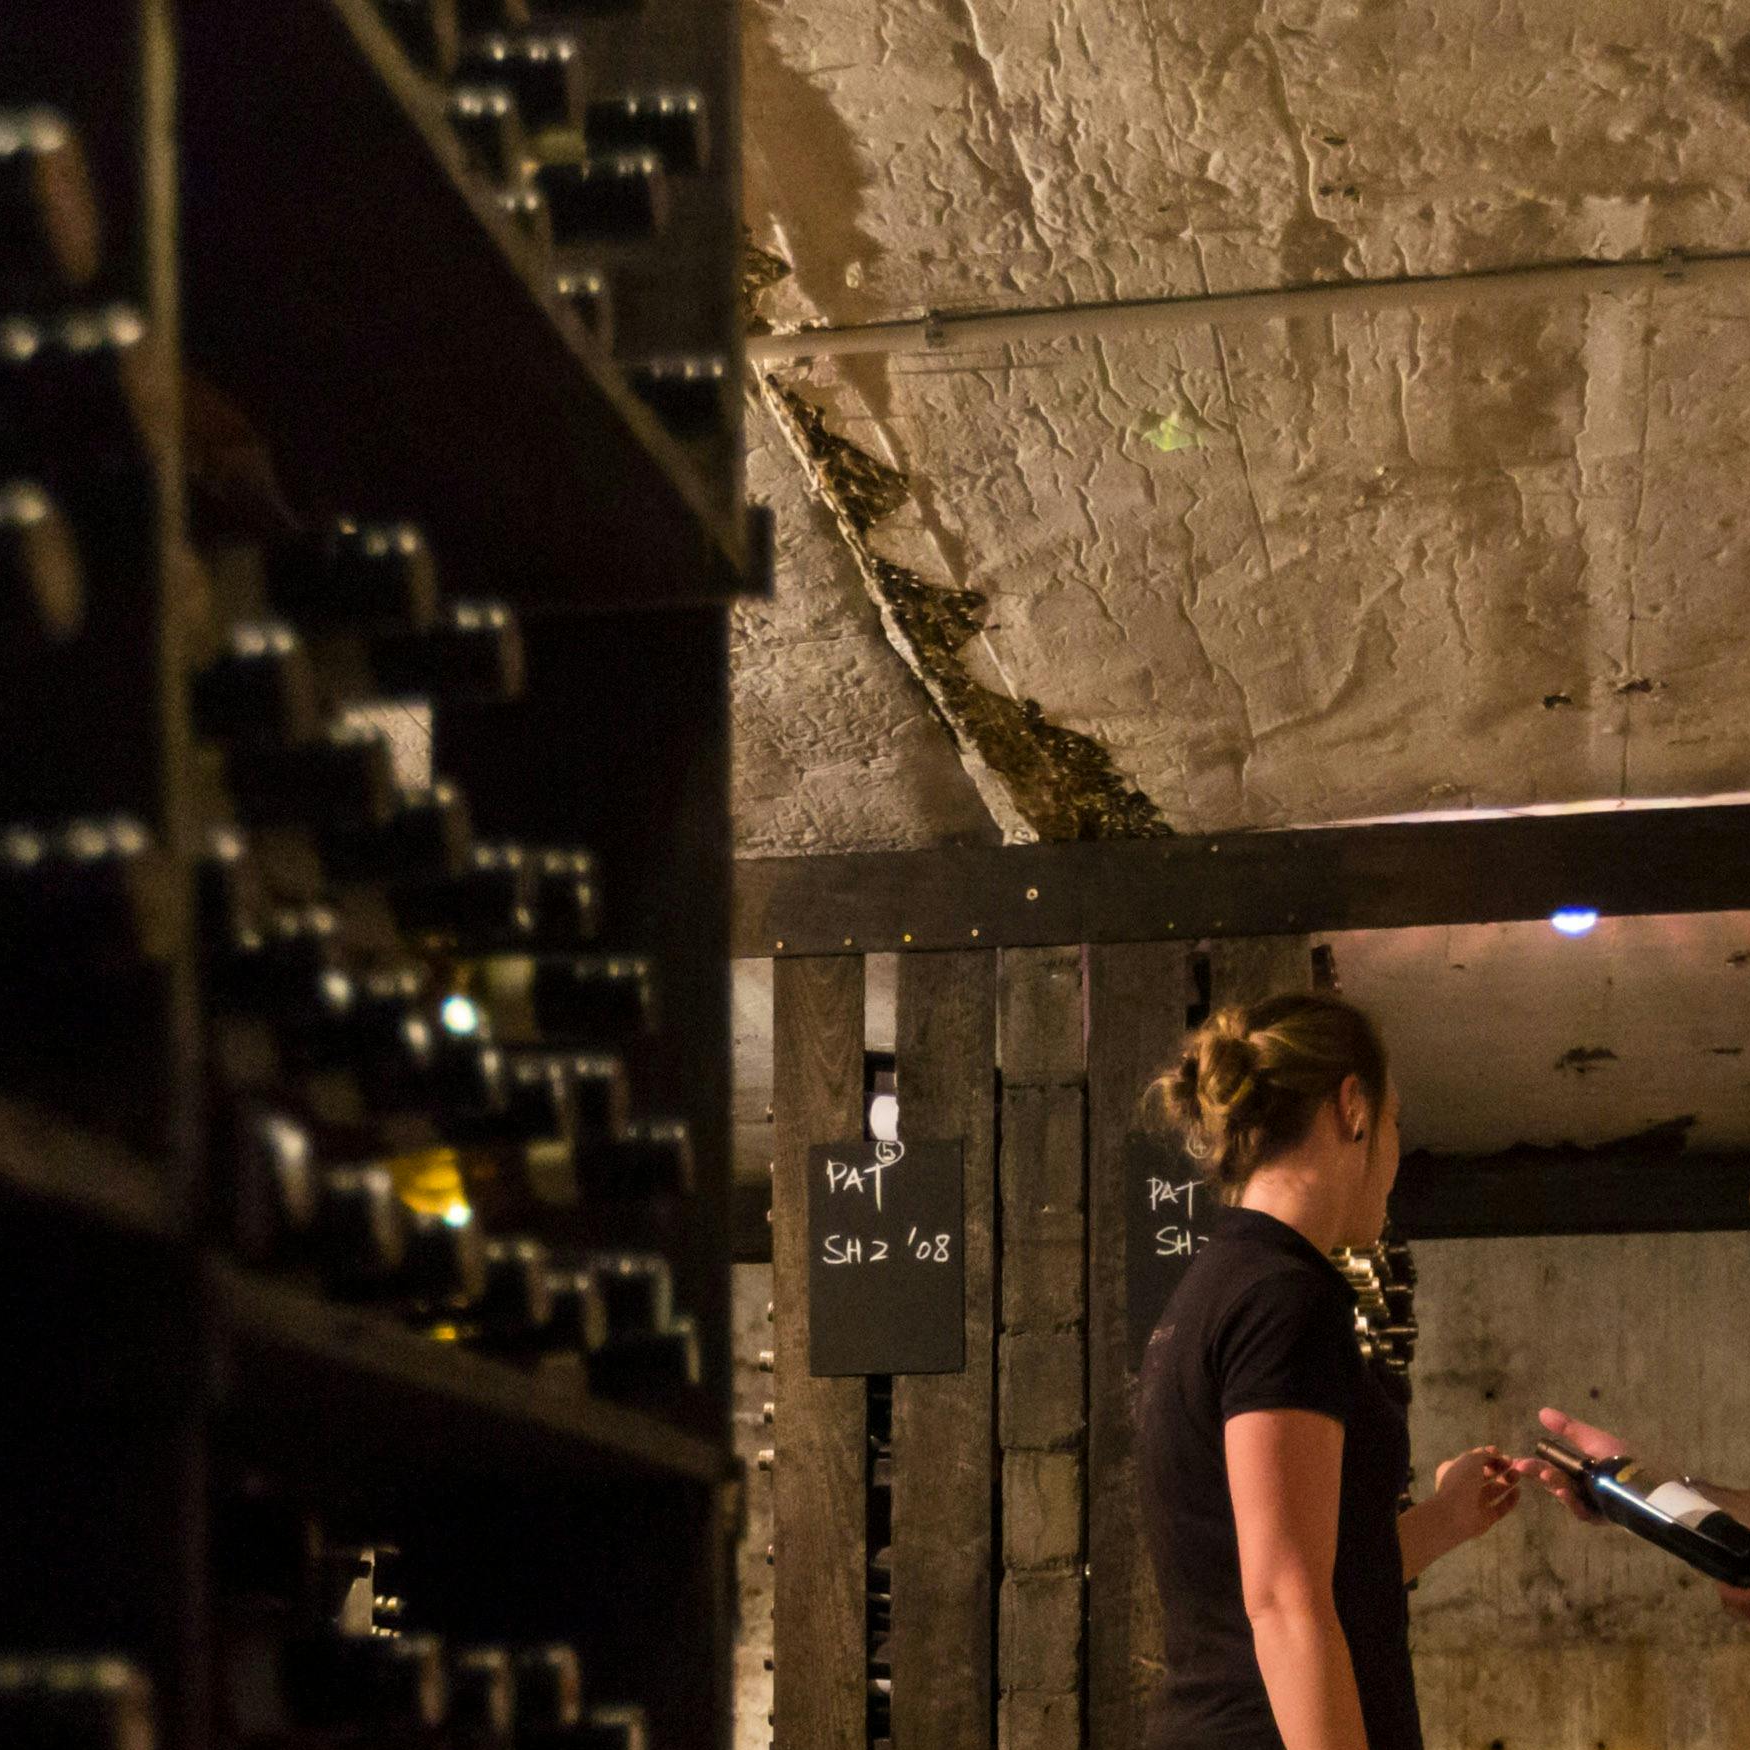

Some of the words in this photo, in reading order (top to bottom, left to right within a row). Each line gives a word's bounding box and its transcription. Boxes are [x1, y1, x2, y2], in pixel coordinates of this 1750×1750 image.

[826, 1159, 892, 1212] PAT
[1146, 1177, 1205, 1219] PAT
[907, 1226, 951, 1263] '08
